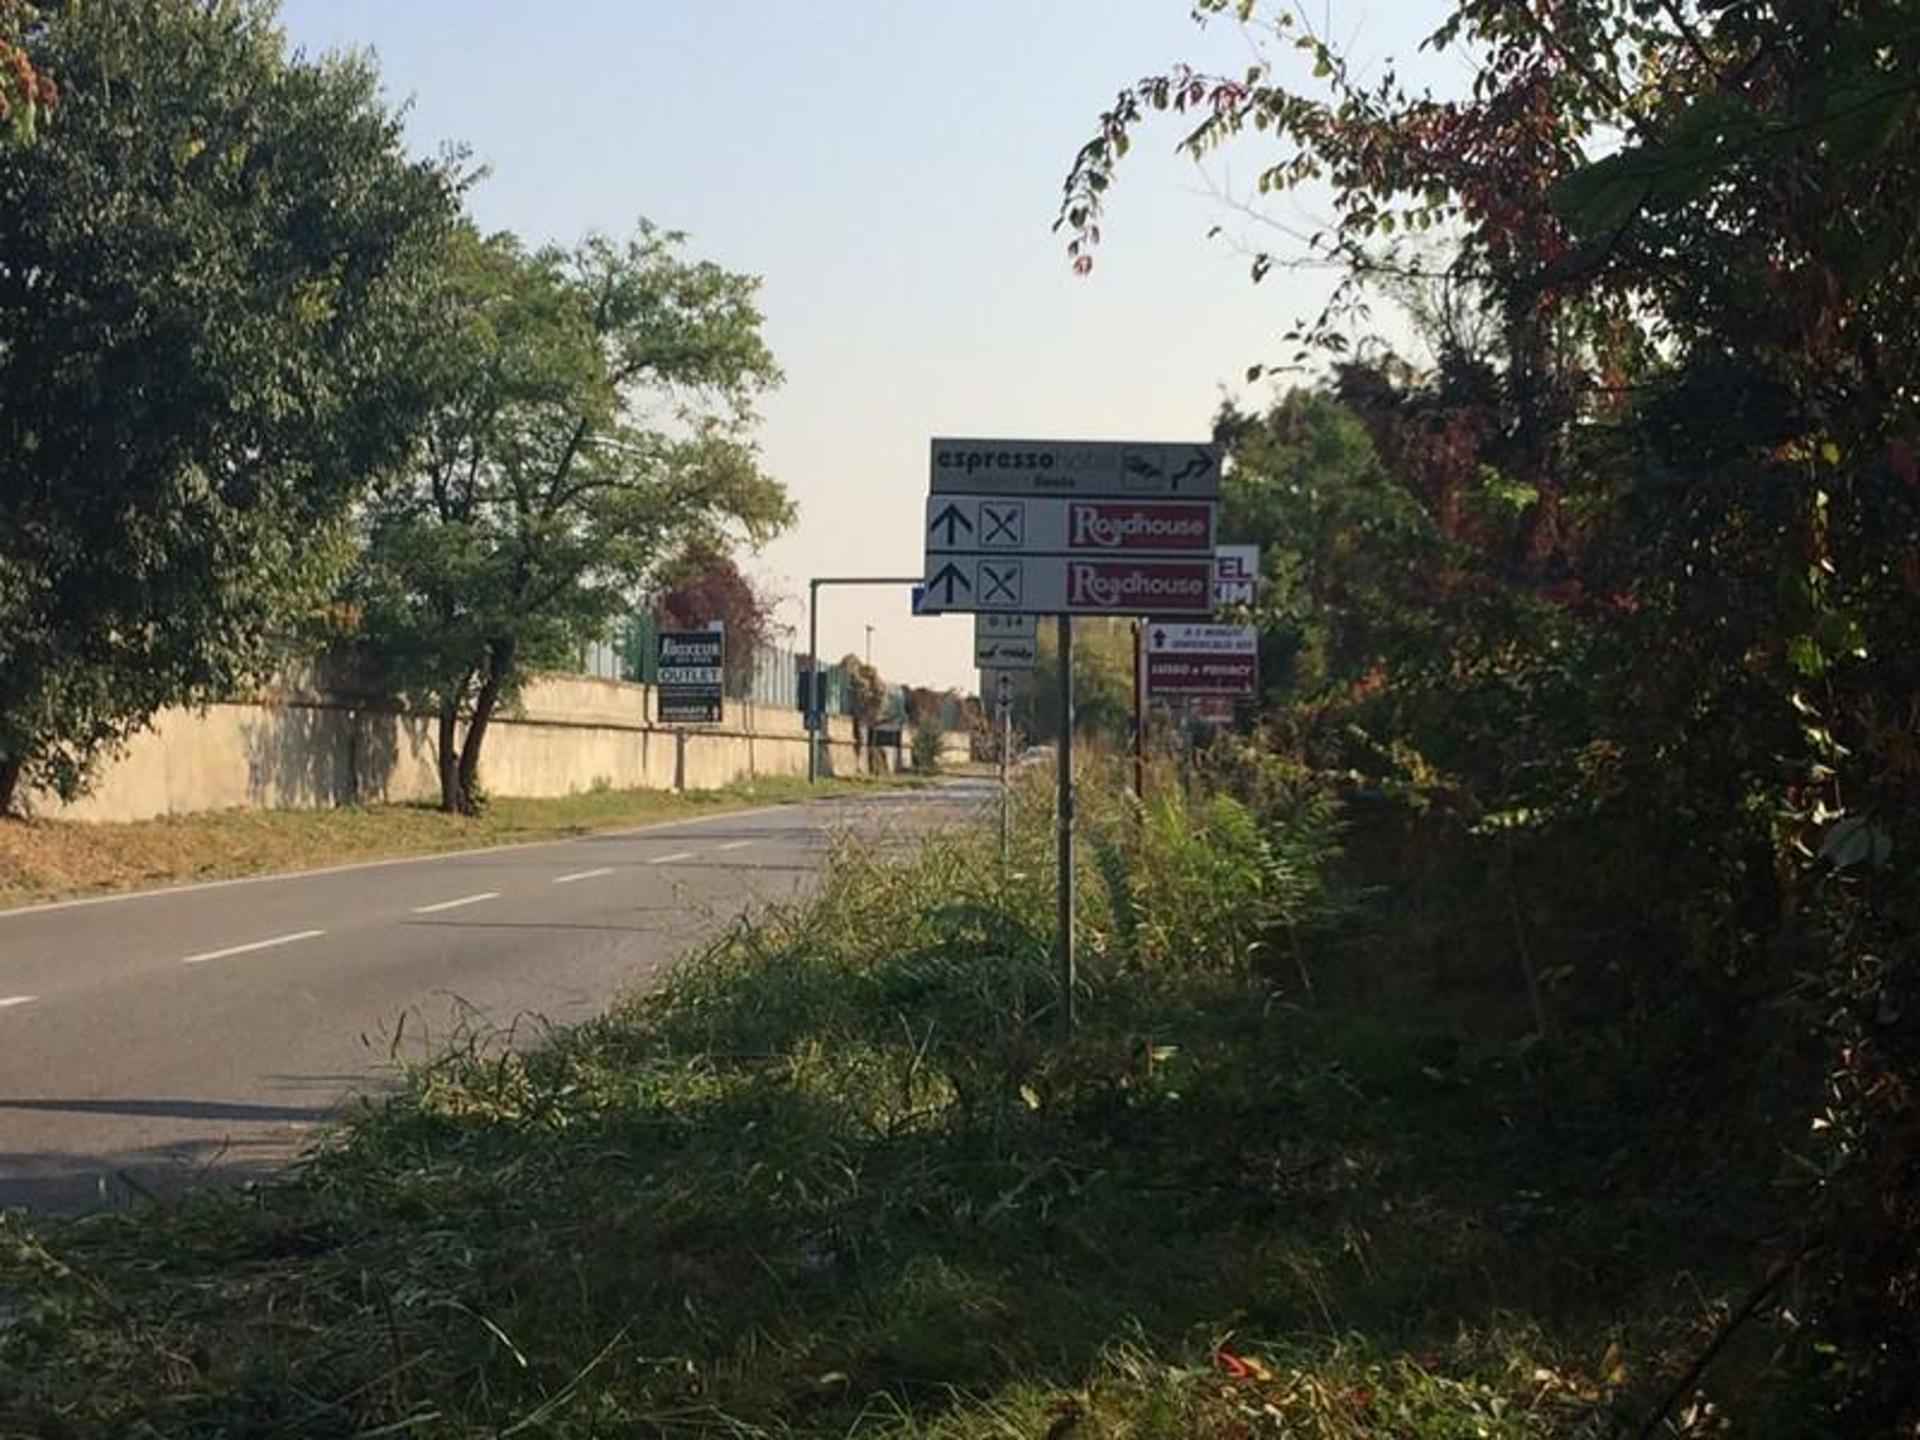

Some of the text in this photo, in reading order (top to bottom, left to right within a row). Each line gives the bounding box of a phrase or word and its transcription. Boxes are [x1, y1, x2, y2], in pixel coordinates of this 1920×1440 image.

[937, 450, 1055, 474] espresso
[1073, 506, 1206, 545] Roadhouse
[1072, 565, 1204, 605] Roadhouse
[660, 669, 721, 682] OUTLET
